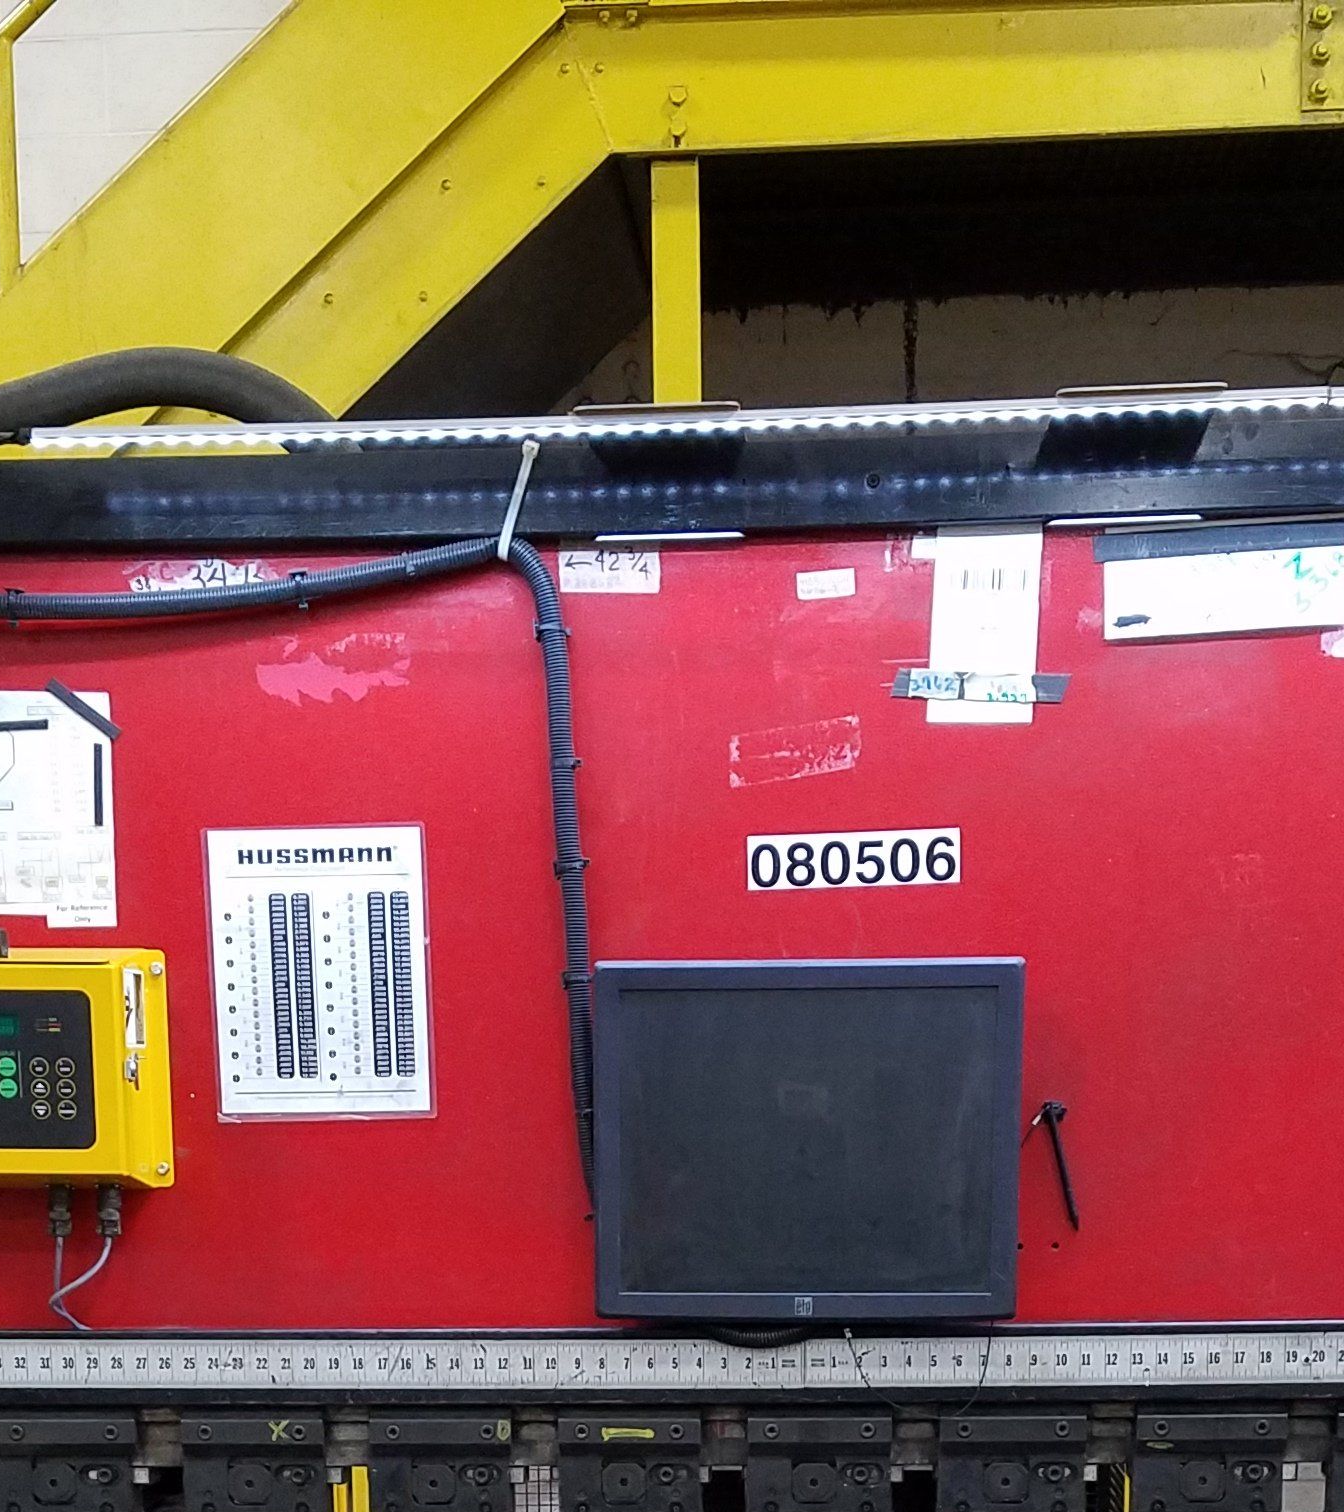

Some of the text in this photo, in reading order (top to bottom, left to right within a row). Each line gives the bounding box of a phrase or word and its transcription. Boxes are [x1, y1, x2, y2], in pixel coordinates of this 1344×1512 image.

[751, 836, 956, 887] 080506
[14, 1356, 26, 1369] 32
[39, 1356, 51, 1369] 31
[62, 1356, 74, 1369] 30
[86, 1356, 99, 1369] 29
[110, 1356, 123, 1369] 28
[136, 1356, 148, 1369] 27
[158, 1356, 171, 1369] 26
[183, 1356, 196, 1369] 25
[207, 1357, 220, 1369] 24
[256, 1357, 268, 1369] 22
[280, 1357, 292, 1369] 21
[303, 1357, 316, 1369] 20
[328, 1357, 340, 1370] 19
[352, 1357, 364, 1370] 18
[377, 1357, 389, 1370] 17
[400, 1357, 412, 1370] 16
[449, 1357, 460, 1370] 14
[473, 1357, 485, 1370] 13
[497, 1357, 509, 1370] 12
[523, 1357, 533, 1370] 11
[545, 1357, 557, 1370] 10
[574, 1357, 581, 1370] 9
[599, 1357, 605, 1370] 8
[624, 1357, 630, 1370] 7
[647, 1357, 654, 1370] 6
[671, 1357, 678, 1370] 5
[696, 1357, 702, 1370] 4
[720, 1357, 727, 1370] 3
[745, 1357, 752, 1370] 2
[770, 1357, 776, 1370] 1
[831, 1356, 836, 1369] 1
[881, 1356, 888, 1368] 3
[906, 1355, 912, 1368] 4
[930, 1355, 937, 1368] 5
[956, 1355, 962, 1367] 6
[1006, 1354, 1012, 1367] 8
[1030, 1354, 1037, 1367] 9
[1056, 1354, 1068, 1366] 10
[1080, 1354, 1092, 1366] 11
[1106, 1353, 1118, 1366] 12
[1131, 1353, 1144, 1366] 13
[1157, 1352, 1168, 1365] 14
[1183, 1351, 1195, 1364] 15
[1208, 1351, 1221, 1364] 16
[1234, 1351, 1246, 1363] 17
[1260, 1350, 1272, 1363] 18
[1286, 1350, 1298, 1363] 19
[1312, 1350, 1325, 1362] 20
